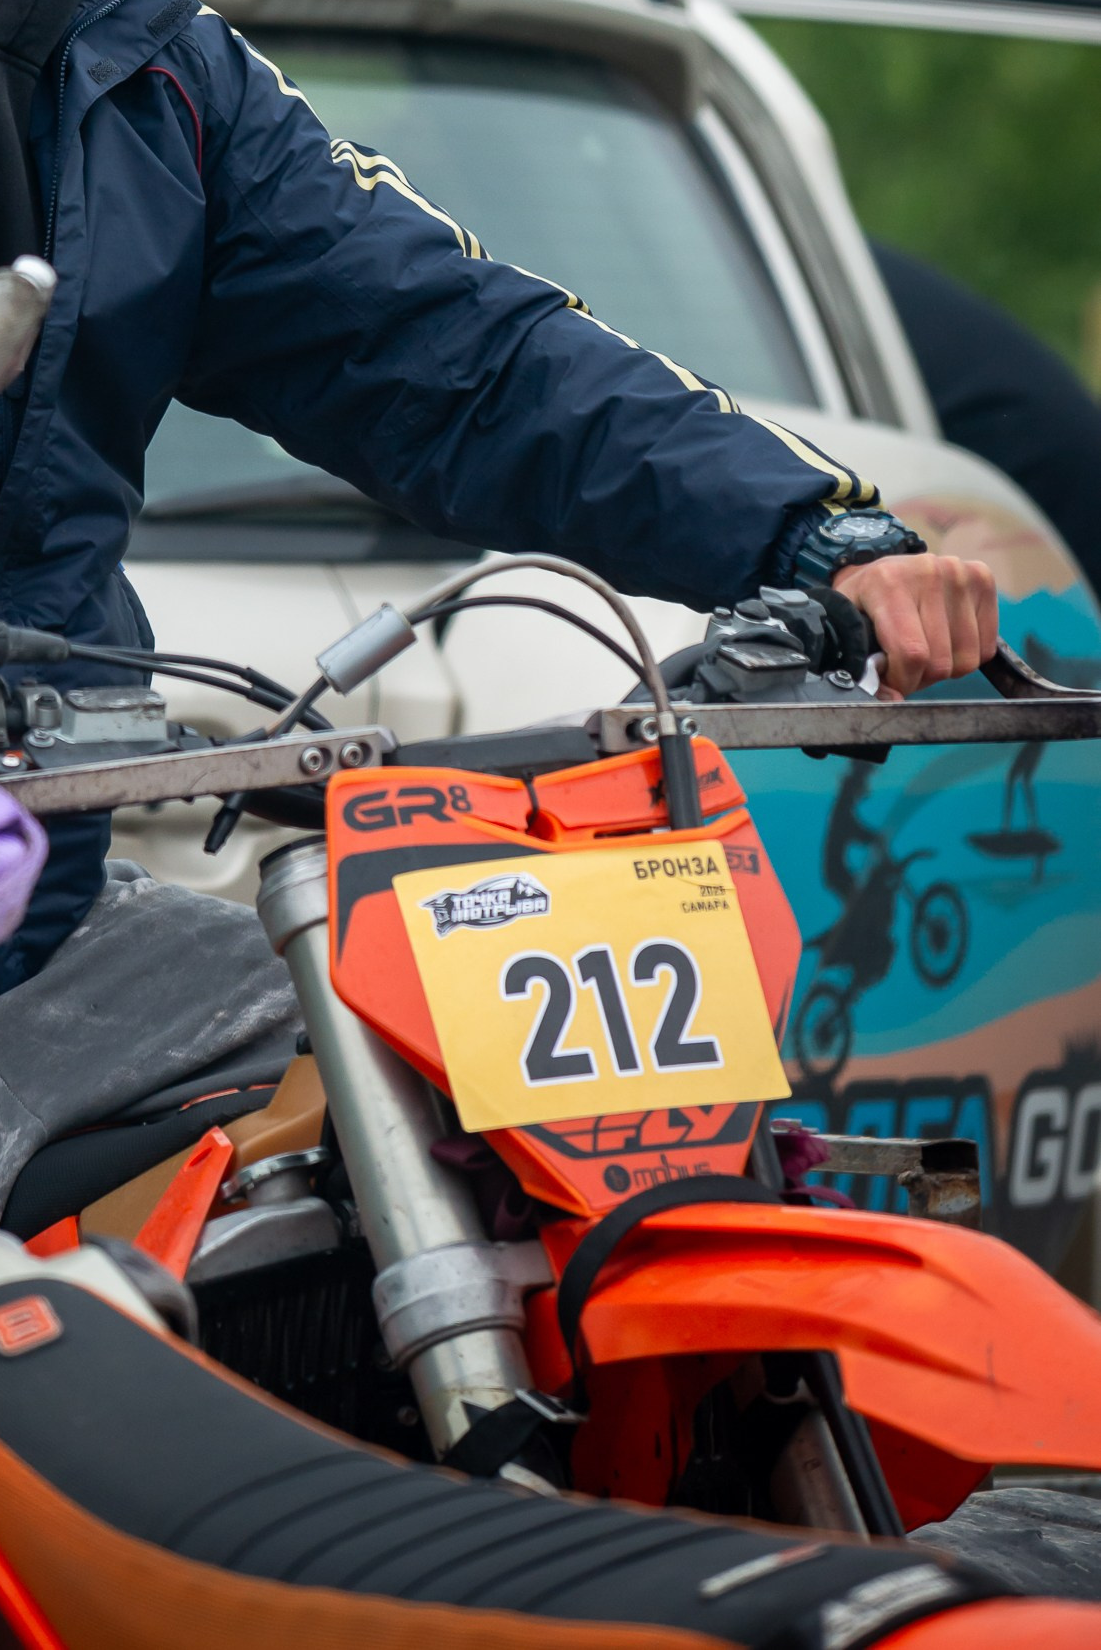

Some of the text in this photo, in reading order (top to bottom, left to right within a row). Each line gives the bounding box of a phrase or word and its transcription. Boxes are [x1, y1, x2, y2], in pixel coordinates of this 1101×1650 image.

[342, 784, 472, 832] GR8
[633, 855, 720, 880] БРОНЗА
[451, 890, 512, 910] ТОЧКА
[680, 899, 730, 914] САМАРА
[499, 936, 724, 1087] 212
